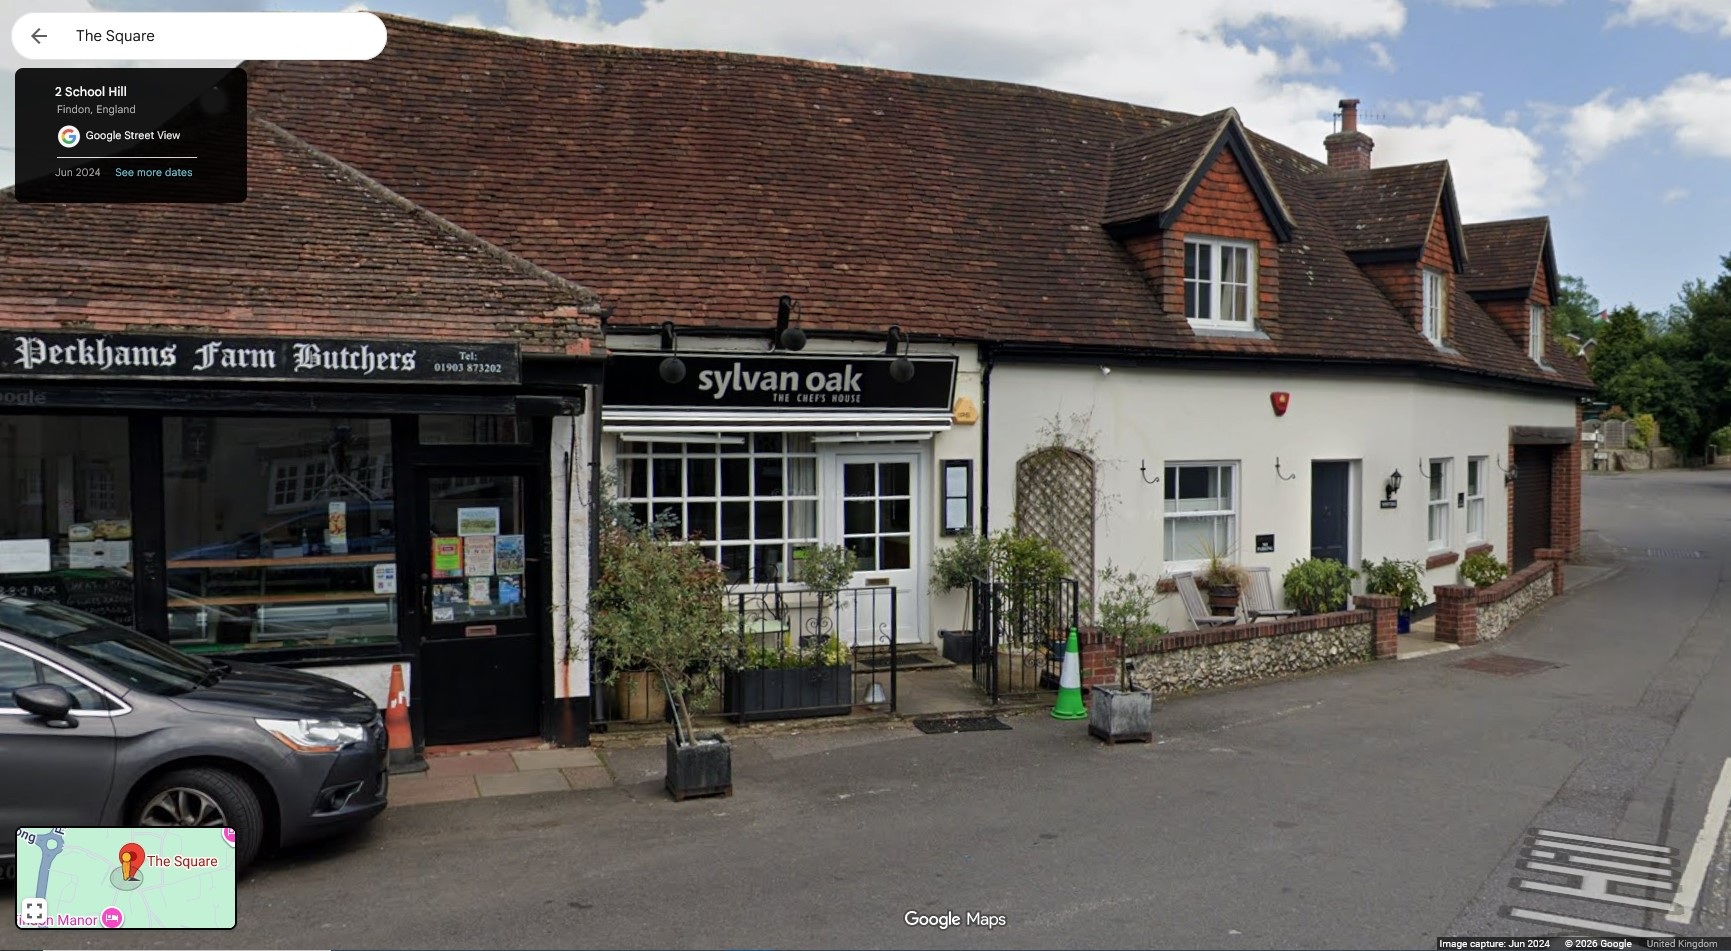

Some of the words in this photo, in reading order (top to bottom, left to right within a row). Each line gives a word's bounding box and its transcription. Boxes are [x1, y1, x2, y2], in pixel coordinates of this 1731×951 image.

[14, 336, 177, 371] Peckhams
[192, 341, 276, 371] Farm
[292, 343, 417, 376] Butchers
[459, 351, 478, 361] Tel:
[434, 363, 464, 373] 01903
[466, 363, 502, 373] 873202
[698, 362, 799, 399] sylvan
[805, 364, 863, 392] oak
[772, 393, 790, 403] THE
[797, 393, 826, 403] CHEF'S
[831, 394, 861, 404] HOUSE
